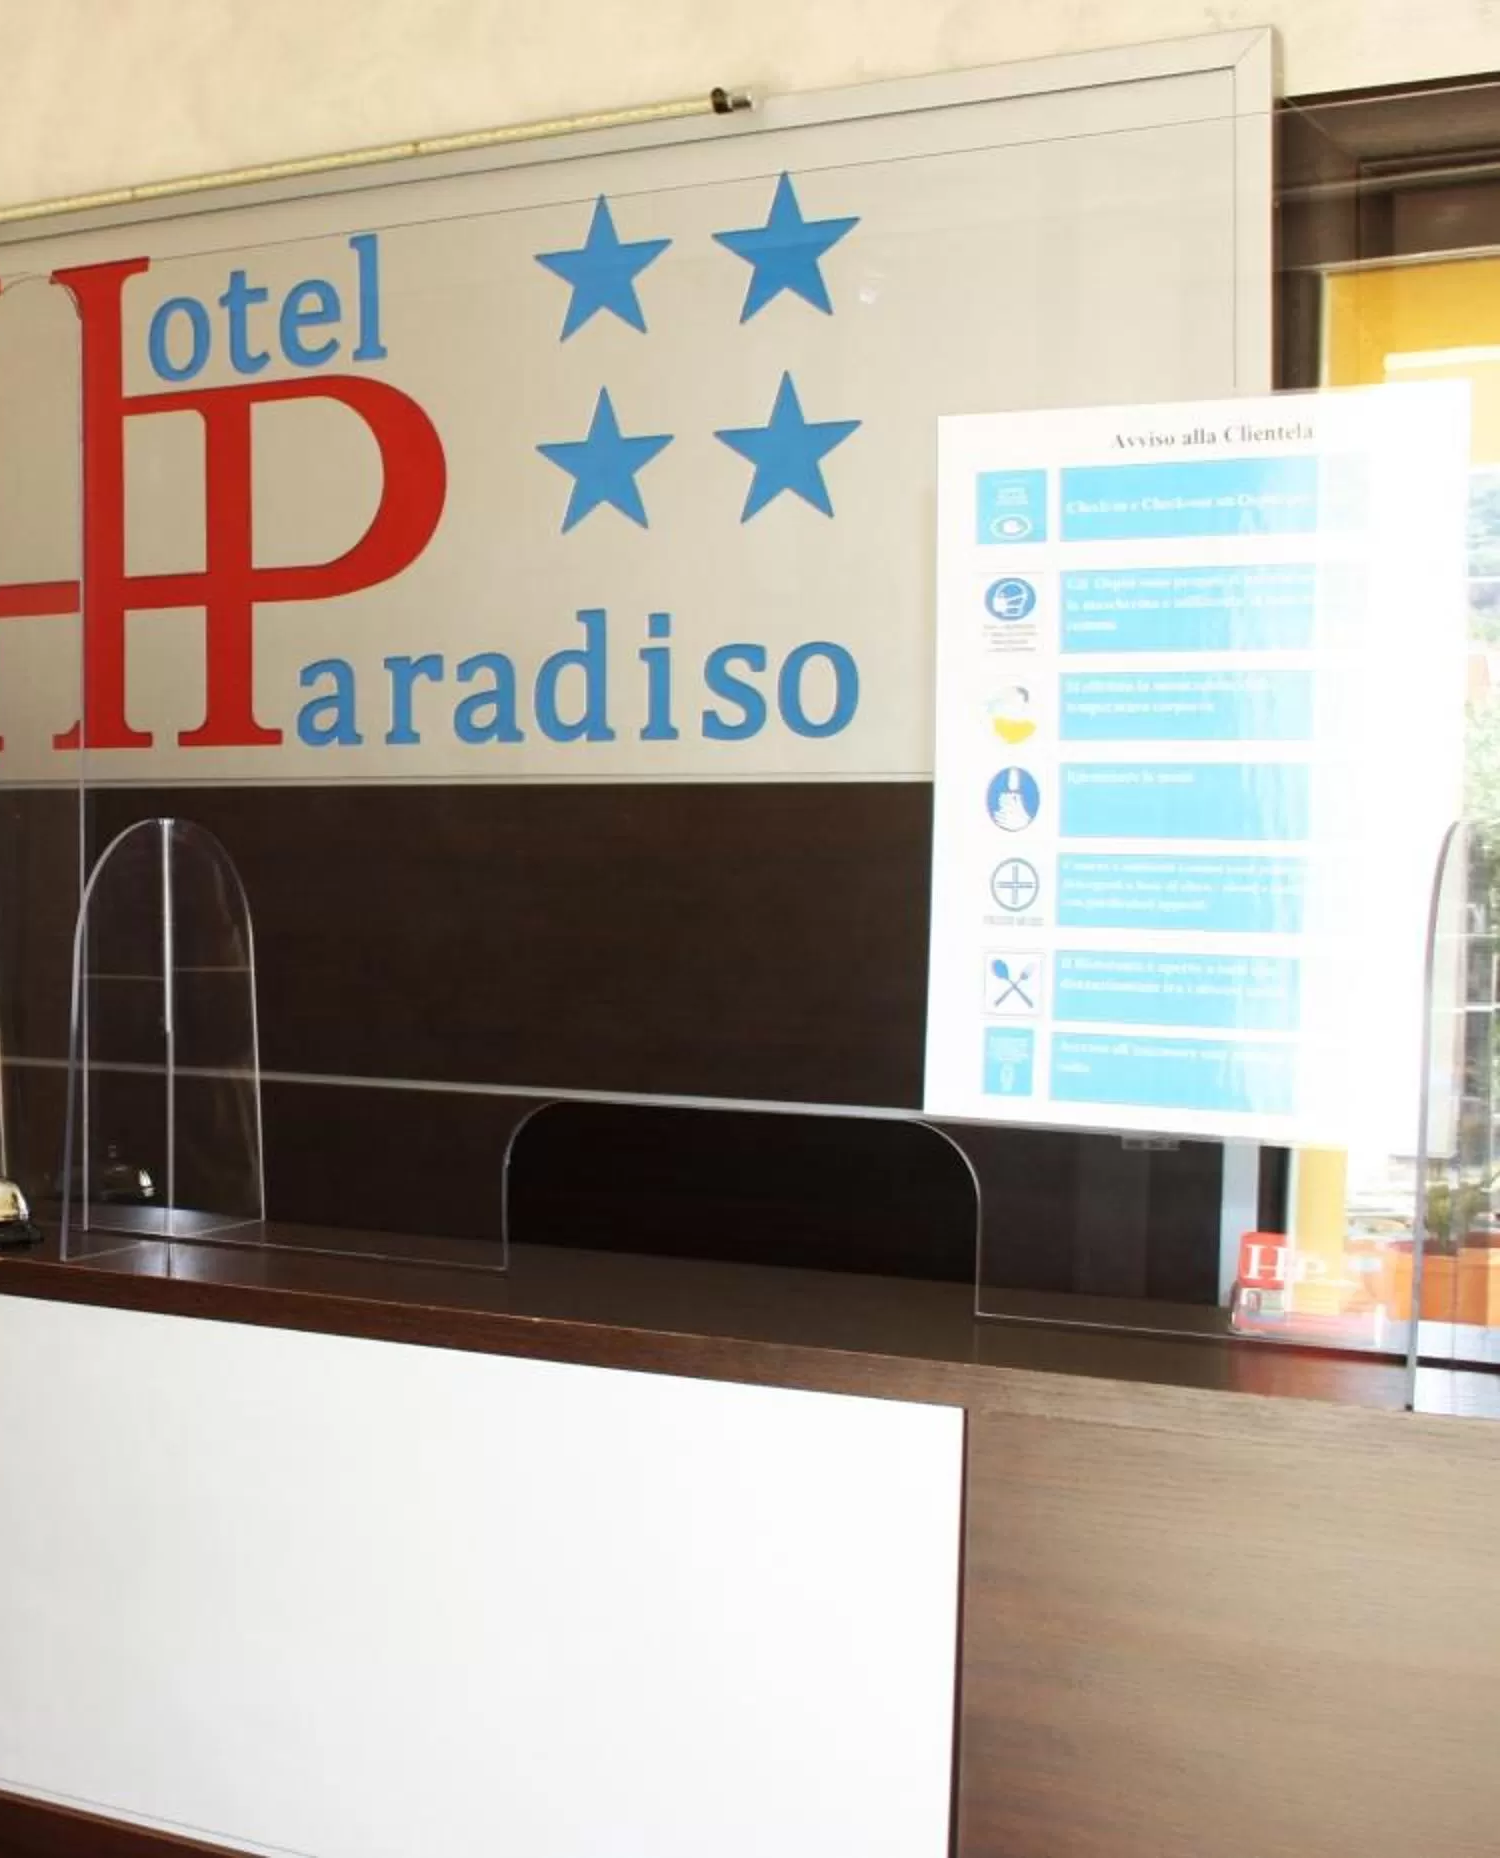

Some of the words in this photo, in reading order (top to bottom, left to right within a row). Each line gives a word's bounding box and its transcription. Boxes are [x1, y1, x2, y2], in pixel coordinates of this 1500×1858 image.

[1110, 433, 1175, 450] Avviso
[1181, 427, 1217, 446] alla
[1220, 422, 1314, 445] Clientela
